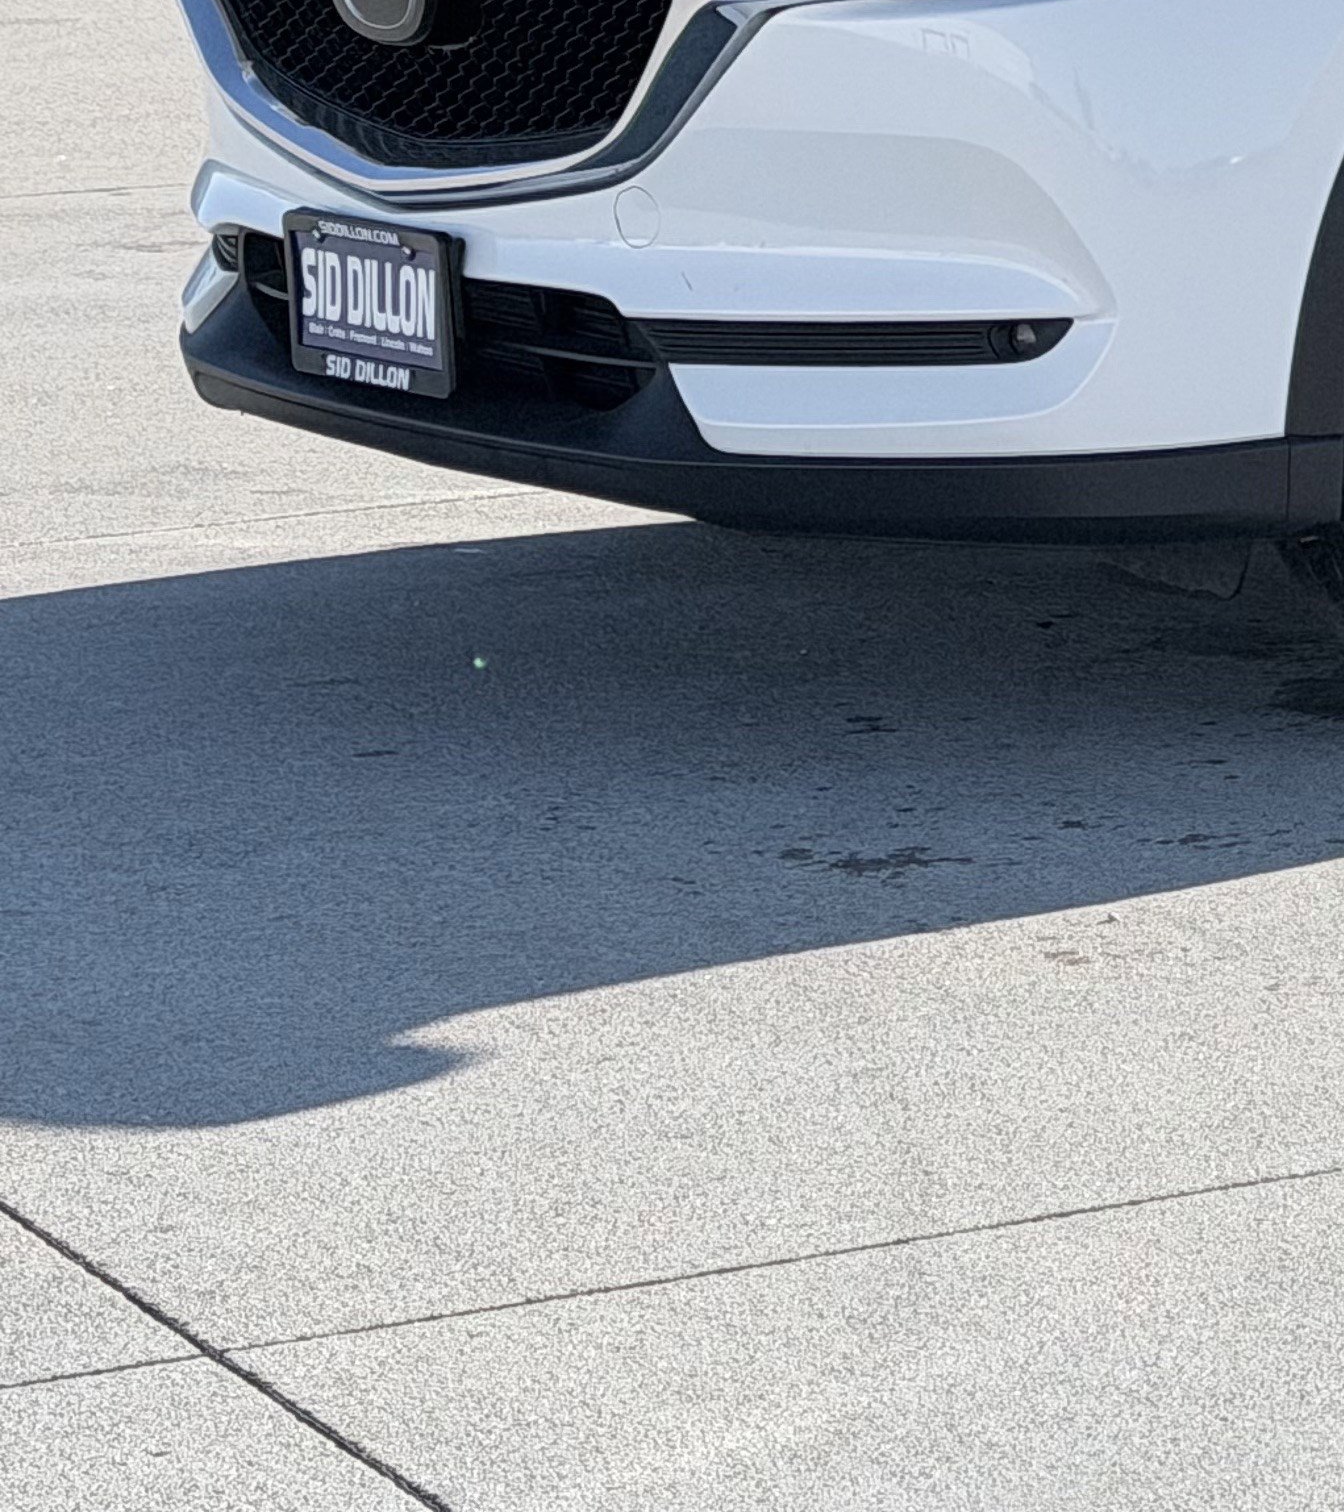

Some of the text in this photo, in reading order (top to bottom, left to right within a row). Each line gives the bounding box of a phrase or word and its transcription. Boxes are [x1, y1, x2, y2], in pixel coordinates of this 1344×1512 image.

[318, 220, 400, 246] SIDDILLON.COM
[302, 247, 342, 321] SID
[347, 254, 436, 341] DILLON
[326, 354, 410, 391] SID DILLON
